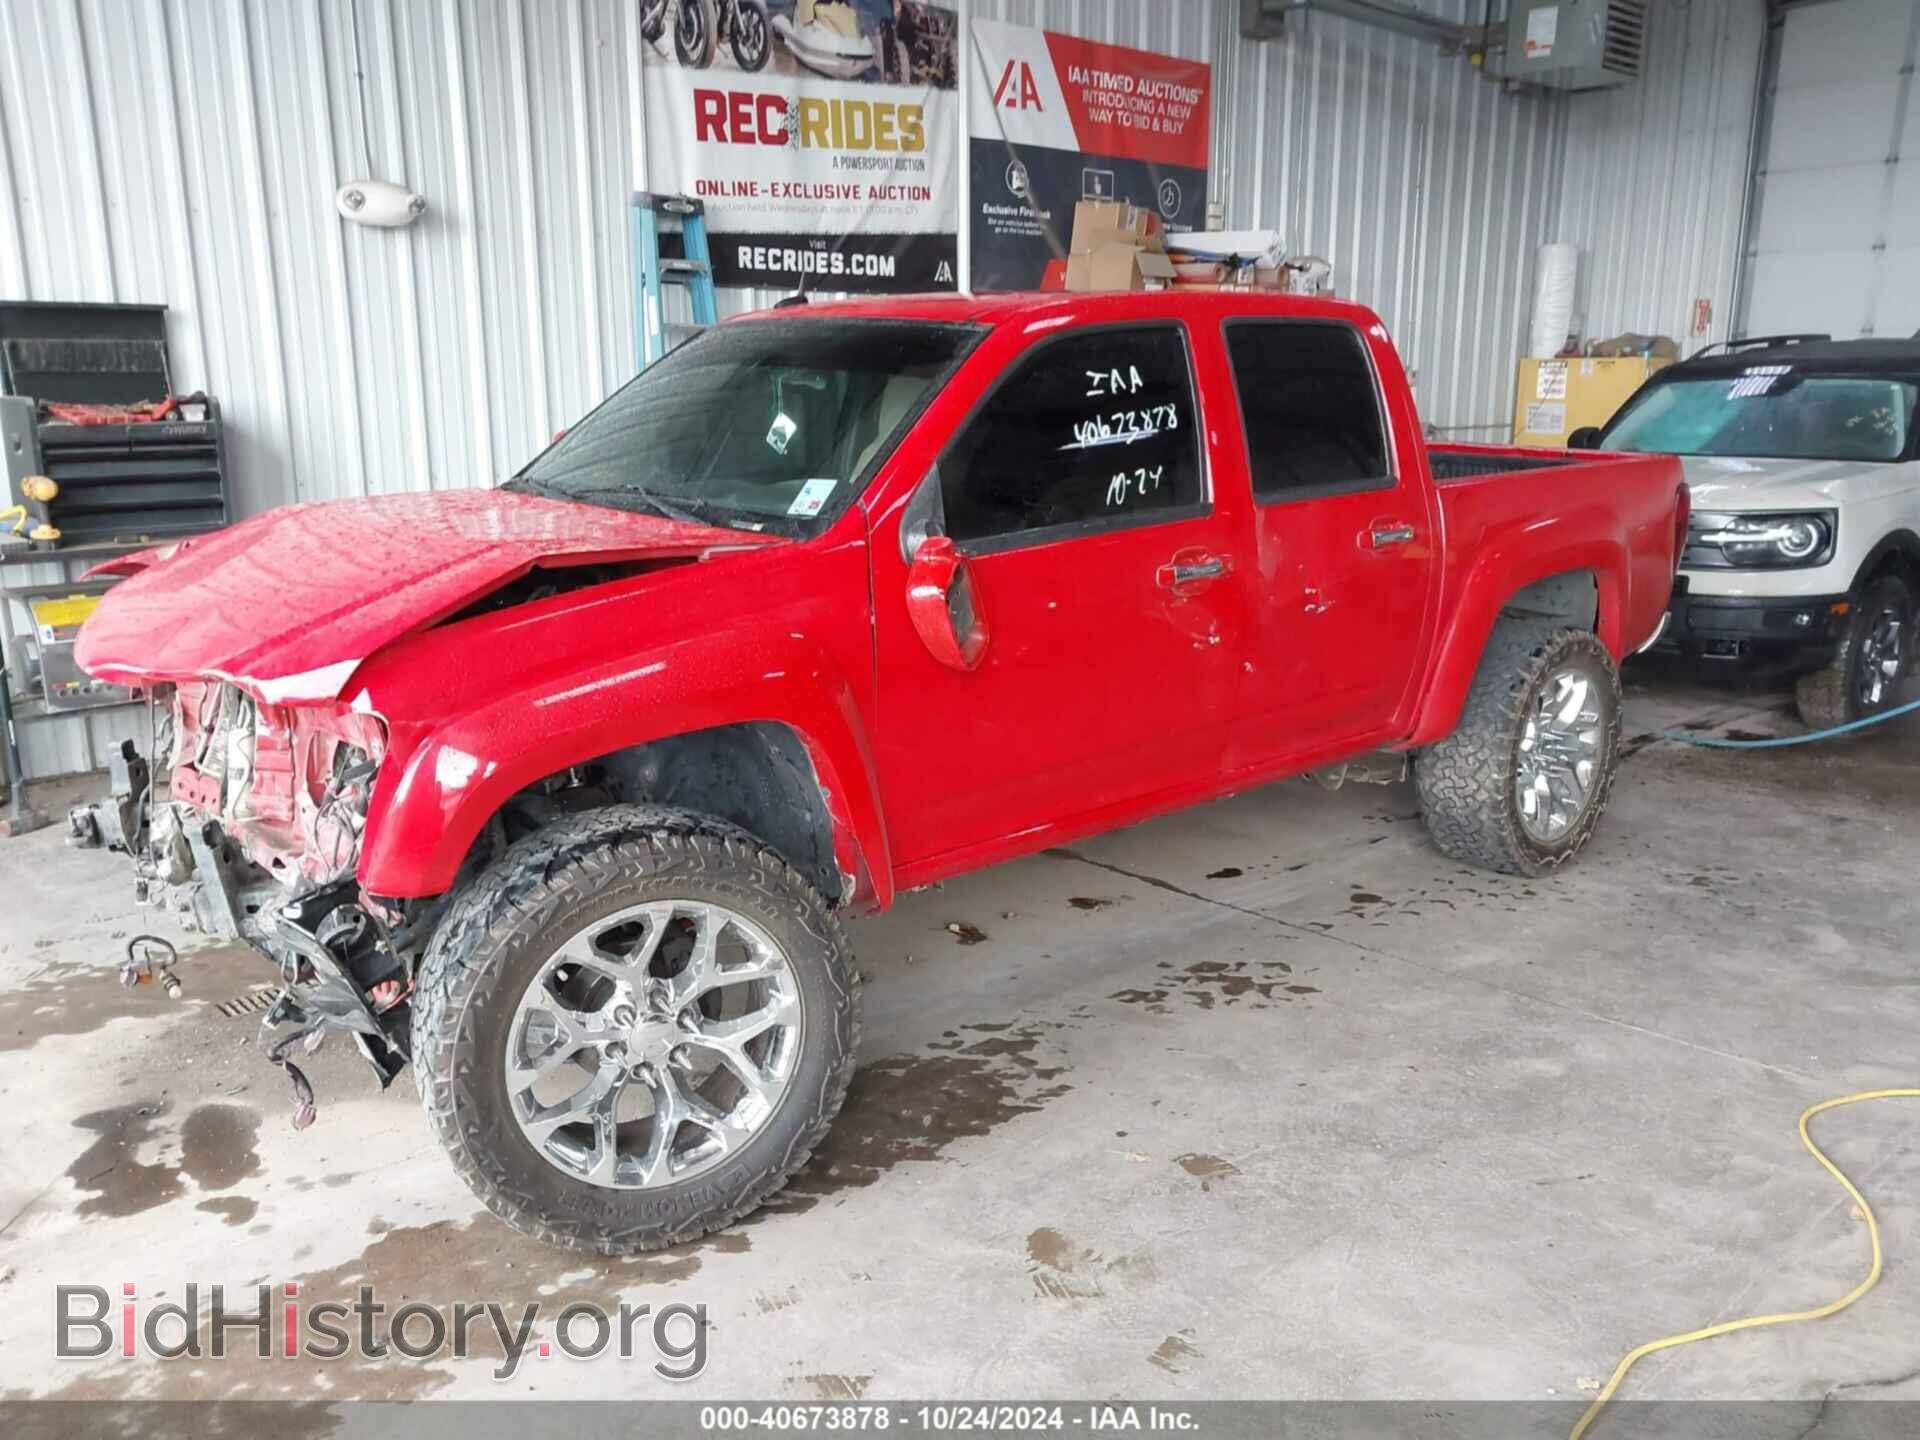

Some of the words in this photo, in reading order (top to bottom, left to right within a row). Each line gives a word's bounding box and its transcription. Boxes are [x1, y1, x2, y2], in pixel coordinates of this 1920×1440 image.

[1068, 65, 1089, 85] IAA
[1091, 70, 1134, 93] TIMED
[1083, 89, 1154, 113] INTRODUCING
[1157, 102, 1165, 116] A
[1167, 103, 1191, 119] NEW
[693, 88, 789, 146] REC
[799, 96, 925, 152] RIDES
[1089, 107, 1113, 125] WAY
[1116, 111, 1132, 127] TO
[1163, 119, 1184, 134] BUY
[832, 156, 839, 169] A
[841, 157, 893, 170] POWERSPORT
[894, 159, 925, 172] AUCTION
[696, 180, 861, 200] ONLINE-EXCLUSIVE
[868, 184, 931, 200] AUCTION
[983, 202, 1018, 216] Exclusive
[809, 239, 826, 249] Visit
[738, 246, 895, 277] RECRIDES.COM
[1086, 365, 1143, 397] IAA
